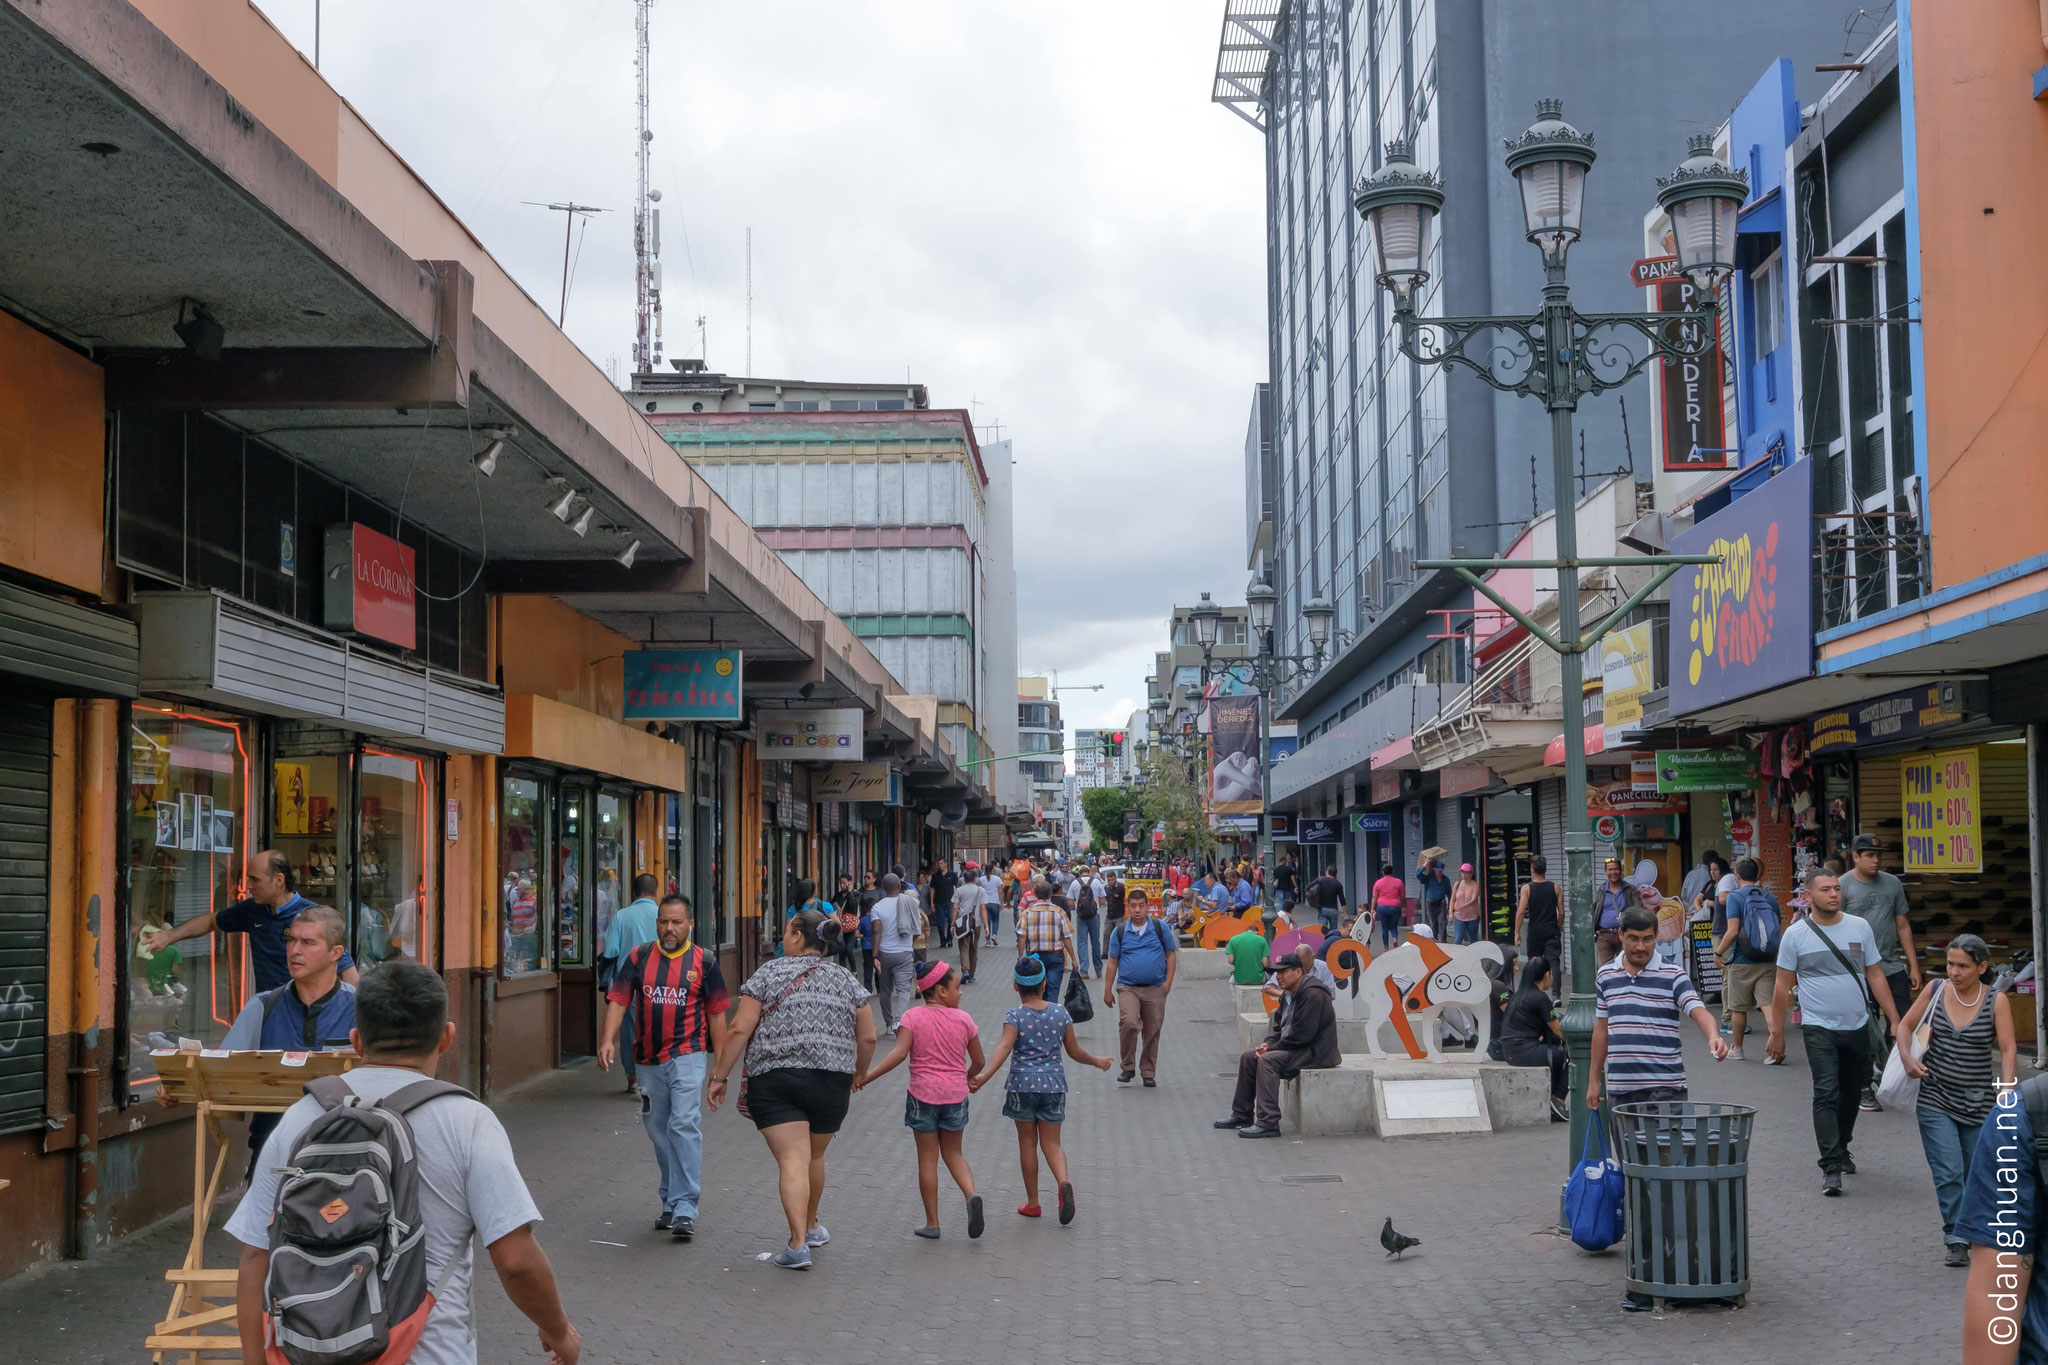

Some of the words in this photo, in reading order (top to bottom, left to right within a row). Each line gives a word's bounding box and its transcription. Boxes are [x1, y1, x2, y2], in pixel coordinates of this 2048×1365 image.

[357, 553, 369, 583] LA
[371, 559, 412, 600] CORONA
[796, 721, 817, 734] La
[1813, 712, 1849, 734] ATENCION
[765, 731, 851, 749] Francesa
[1810, 729, 1857, 753] MAYORISTAS
[1668, 753, 1716, 763] Variedades
[1720, 752, 1746, 762] Sarita
[820, 773, 842, 787] La
[845, 771, 884, 794] Joya
[1945, 760, 1970, 790] 50%
[1611, 791, 1665, 802] PANECILLOS
[1946, 797, 1972, 827] 60%
[1362, 818, 1389, 828] Sucre
[1949, 834, 1974, 863] 70%
[1694, 930, 1707, 940] SOLO
[642, 985, 687, 998] QATAR
[651, 996, 686, 1006] AIRWAYS
